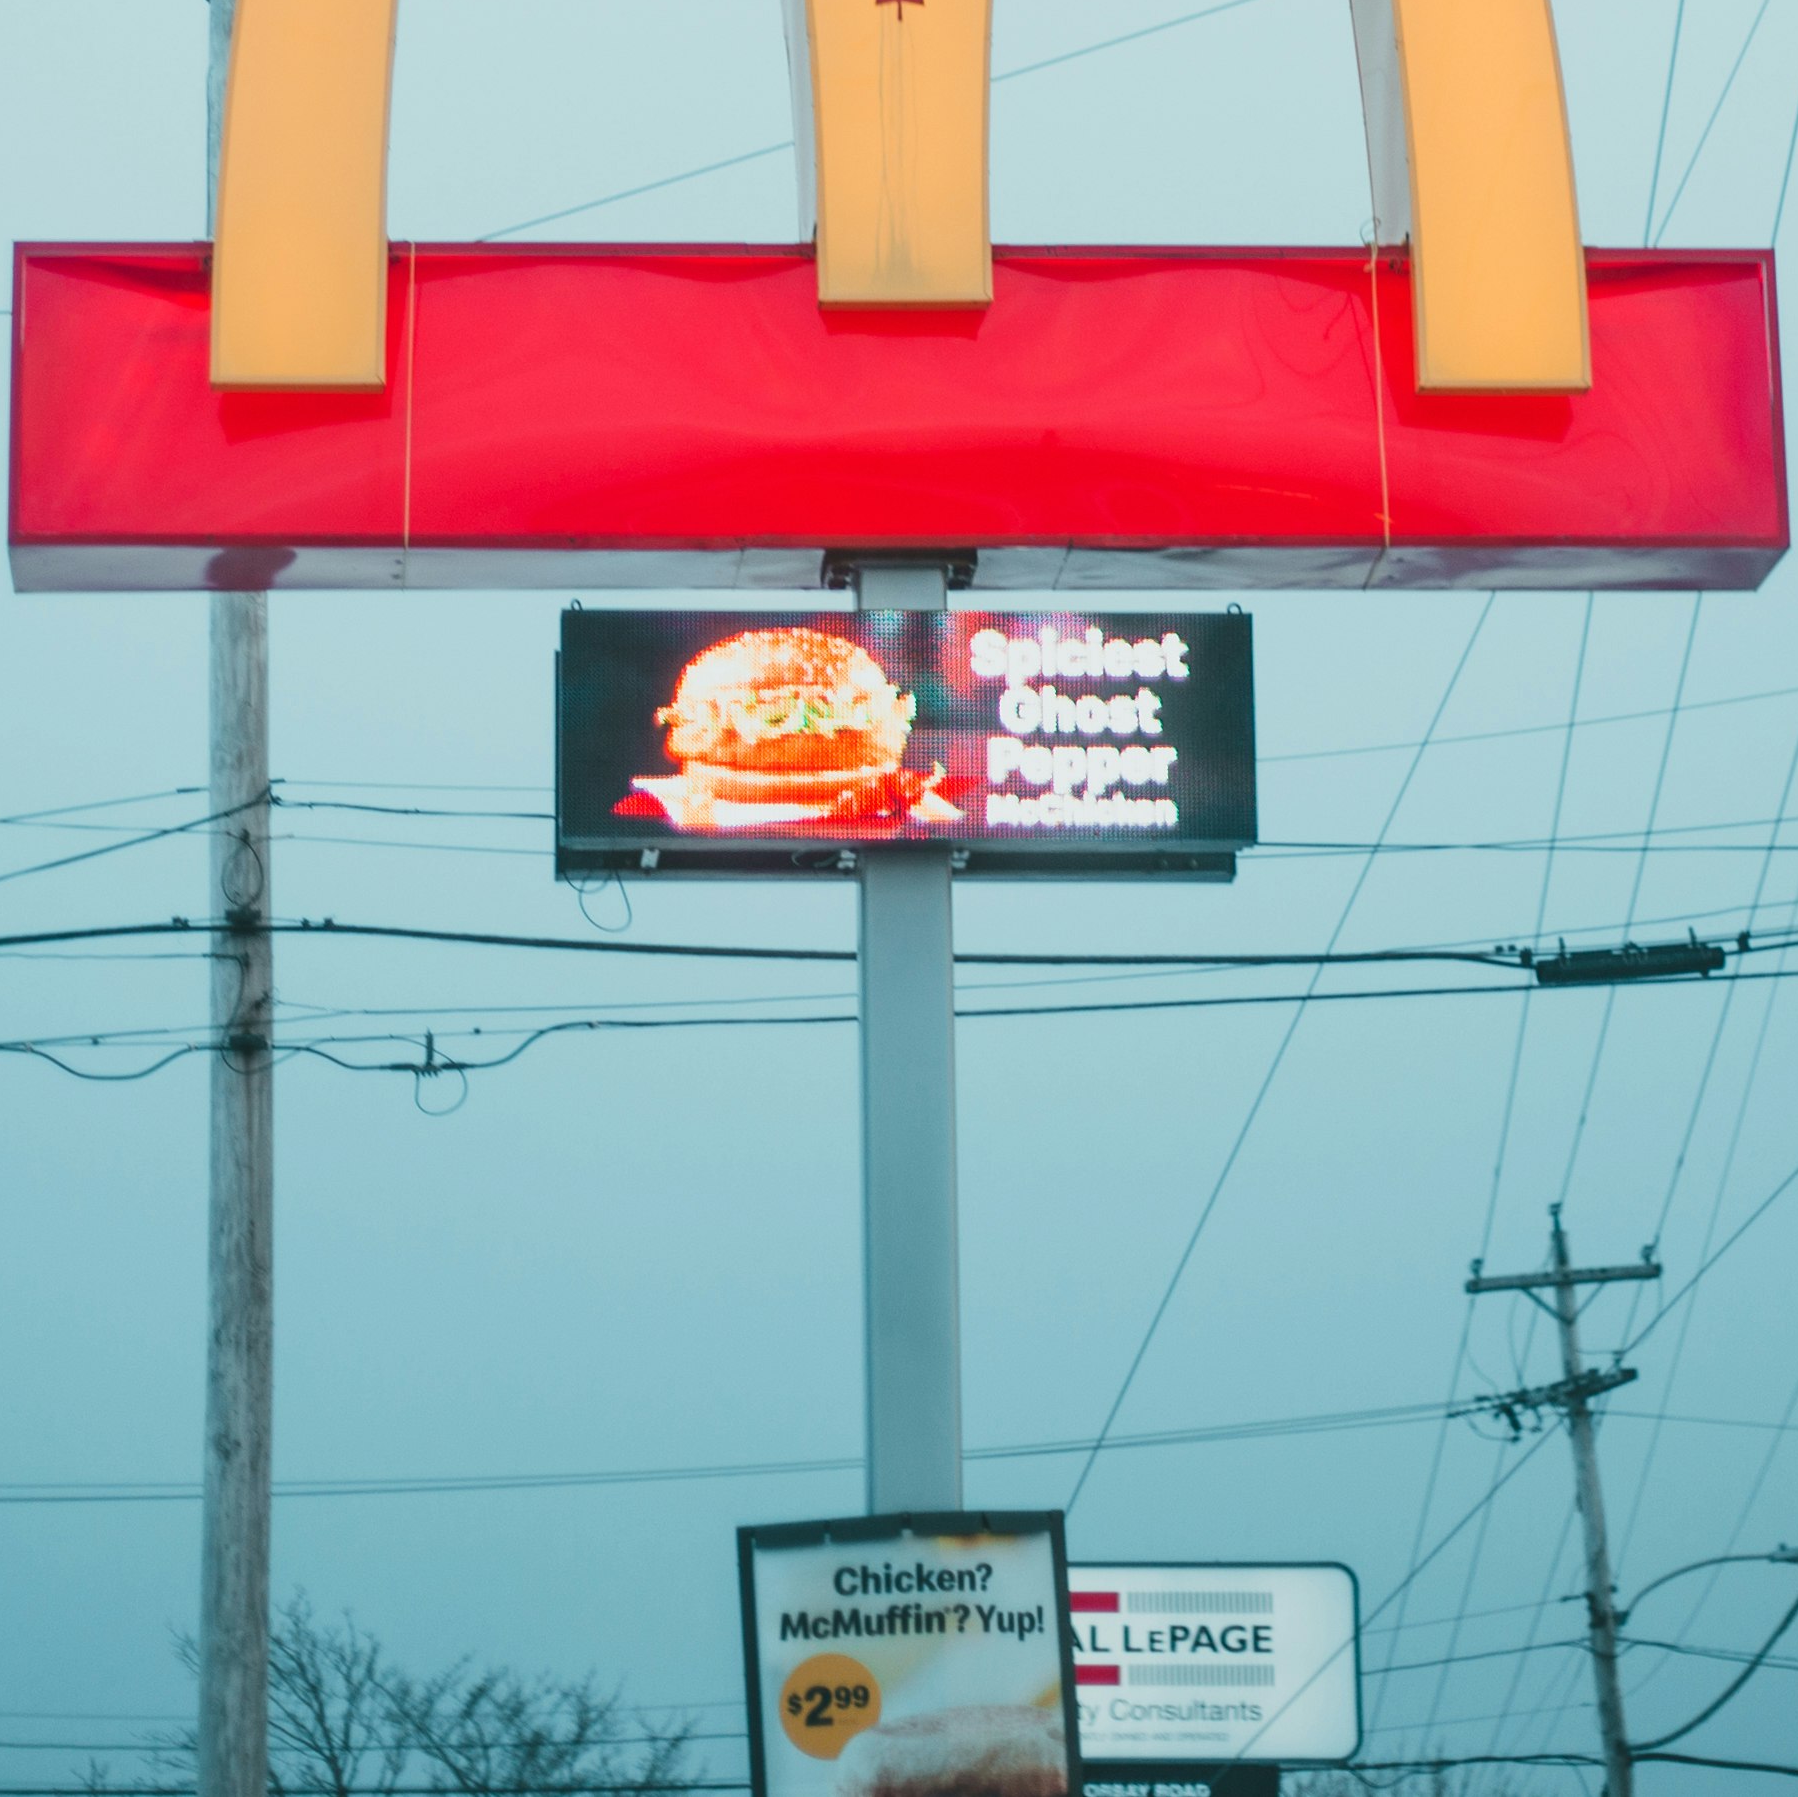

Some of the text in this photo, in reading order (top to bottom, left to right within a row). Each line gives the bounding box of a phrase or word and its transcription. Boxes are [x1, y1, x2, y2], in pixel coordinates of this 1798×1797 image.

[970, 626, 1190, 688] Spiciest
[999, 683, 1163, 734] Ghost
[987, 736, 1178, 794] Pepper
[833, 1562, 993, 1597] Chicken?
[975, 1605, 1044, 1641] Yup!
[1109, 1698, 1263, 1722] Consultants
